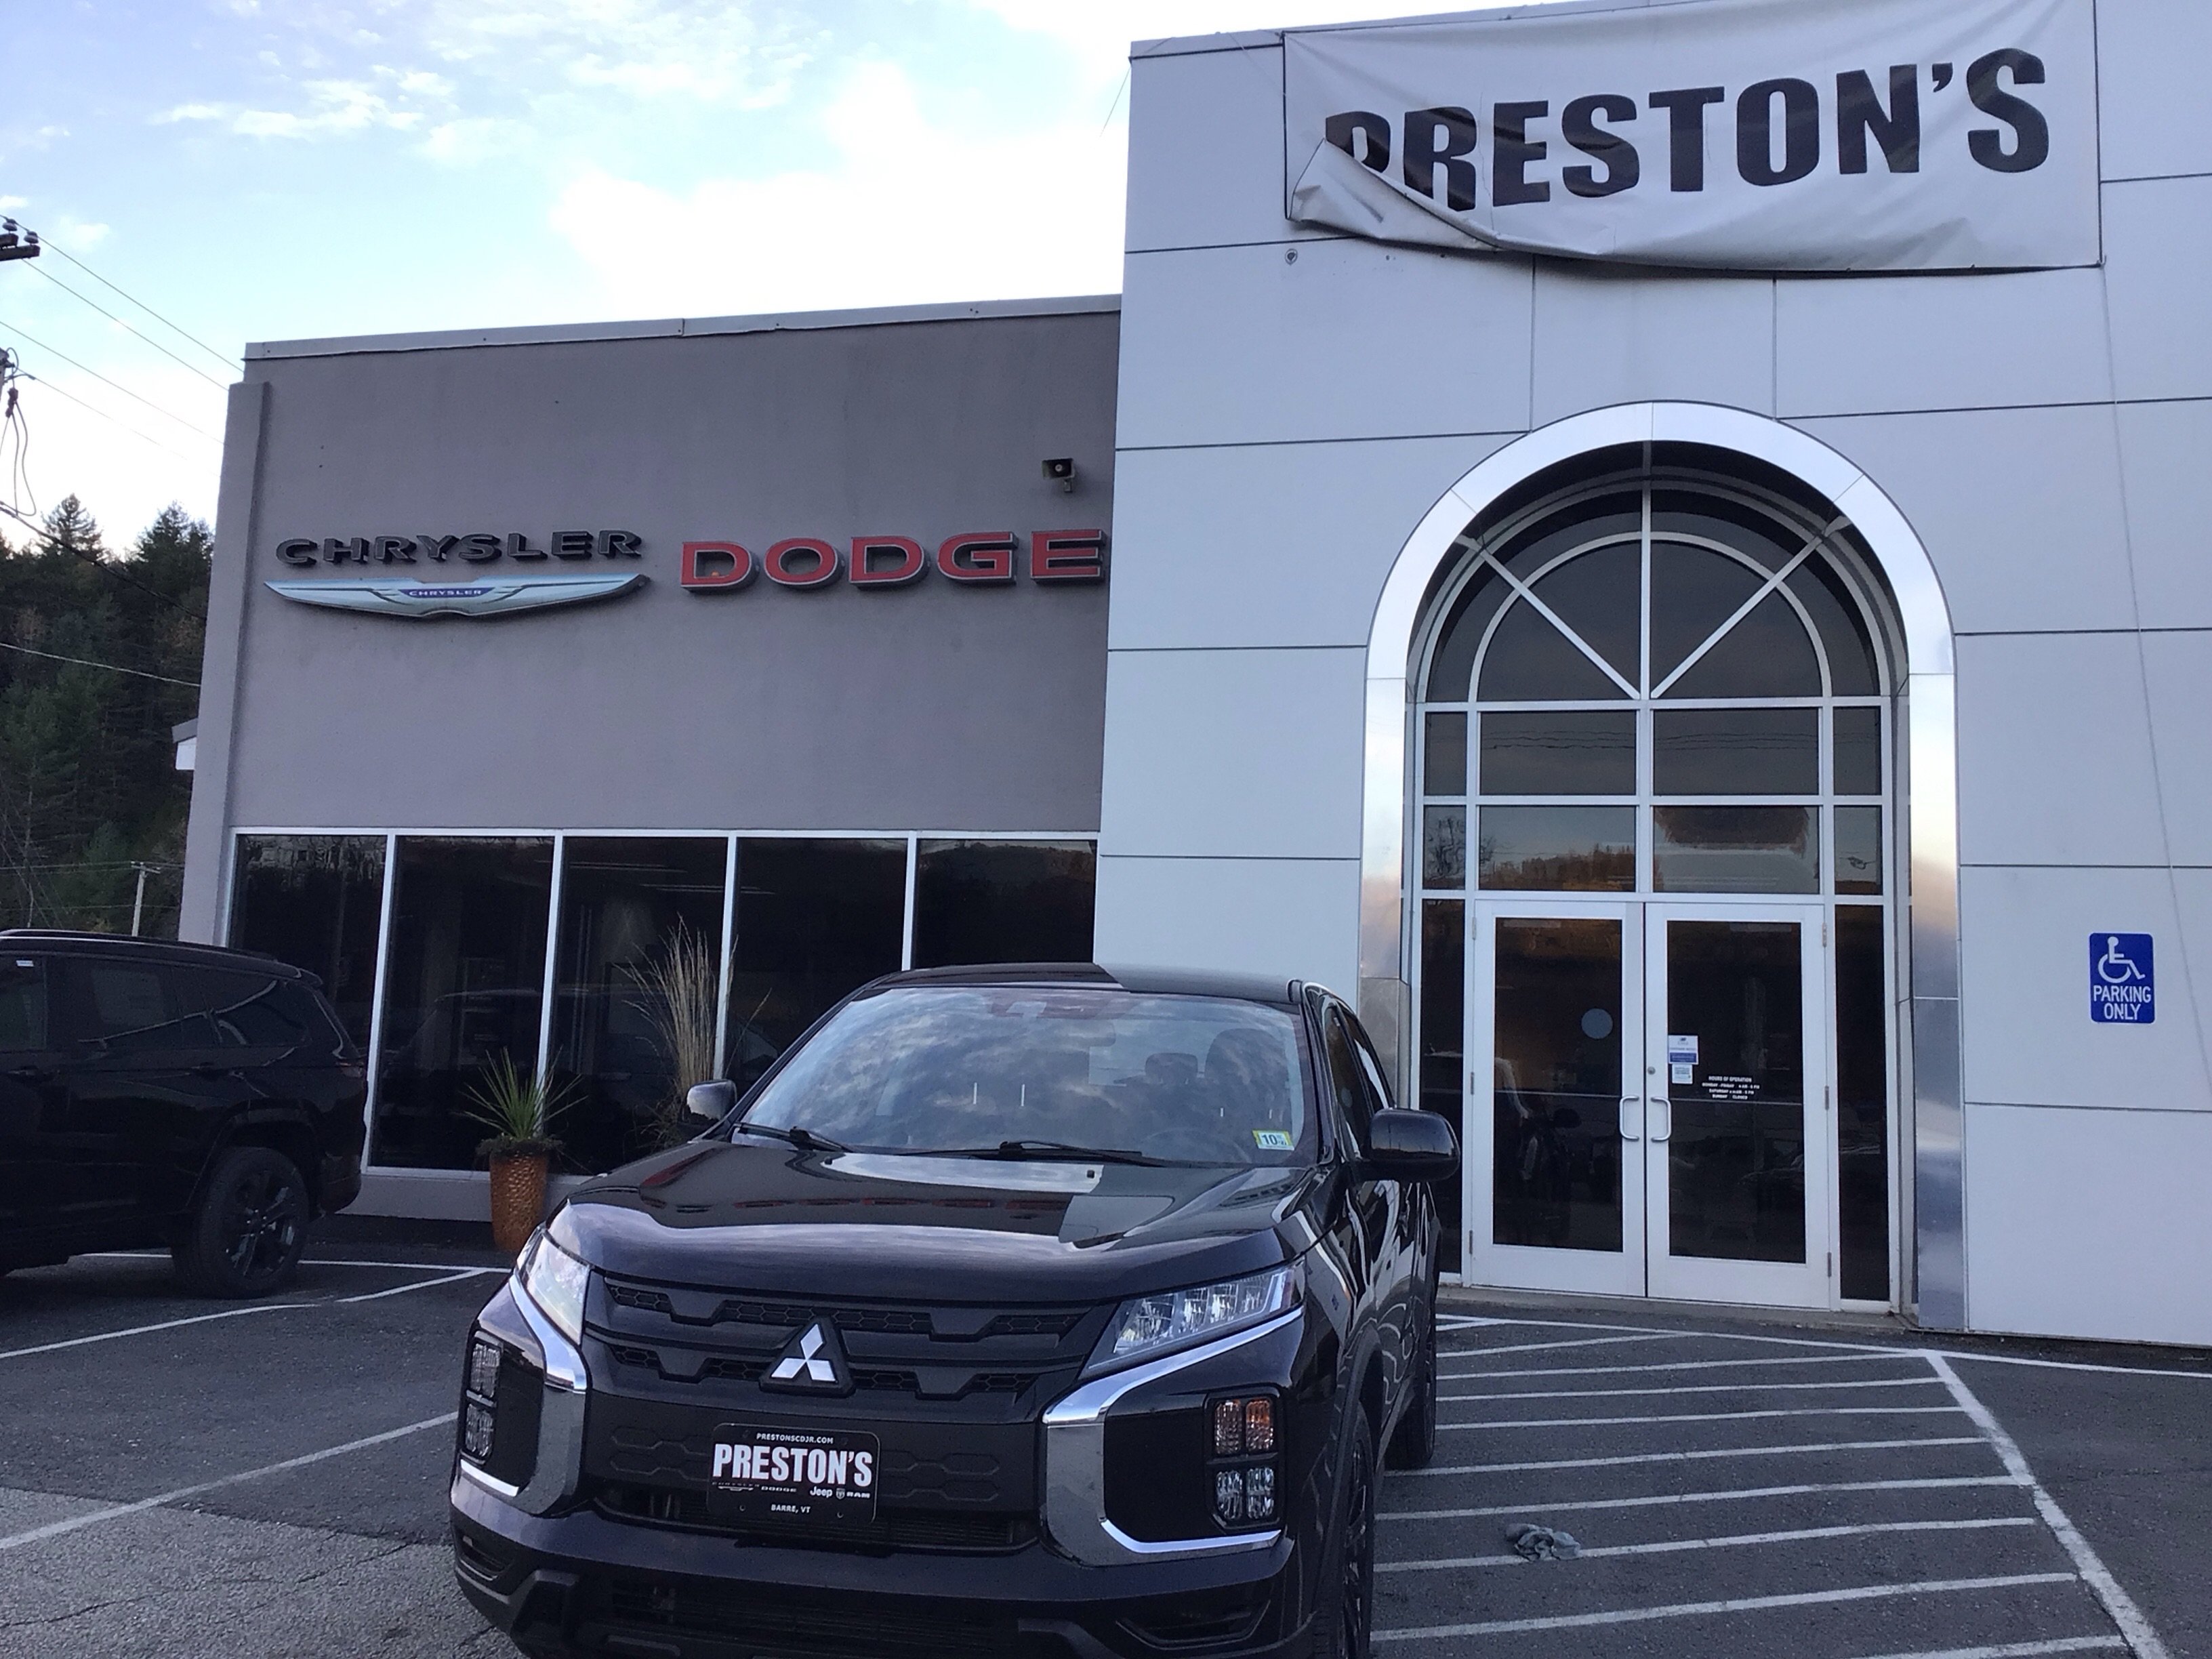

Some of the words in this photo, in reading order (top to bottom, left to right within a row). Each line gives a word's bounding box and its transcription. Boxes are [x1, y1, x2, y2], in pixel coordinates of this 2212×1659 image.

[1324, 47, 2049, 212] PRESTON'S
[276, 529, 642, 565] CHRYSLER
[680, 529, 1106, 591] DODGE
[409, 589, 483, 597] CHRYSLER
[2093, 985, 2152, 1003] PARKING
[2104, 1002, 2141, 1020] ONLY
[1262, 1134, 1278, 1145] 10
[756, 1433, 834, 1444] PRESTONSCDJR.COM
[712, 1443, 873, 1487] PRESTON'S
[810, 1486, 833, 1498] Jeep
[771, 1504, 799, 1513] BARRE,
